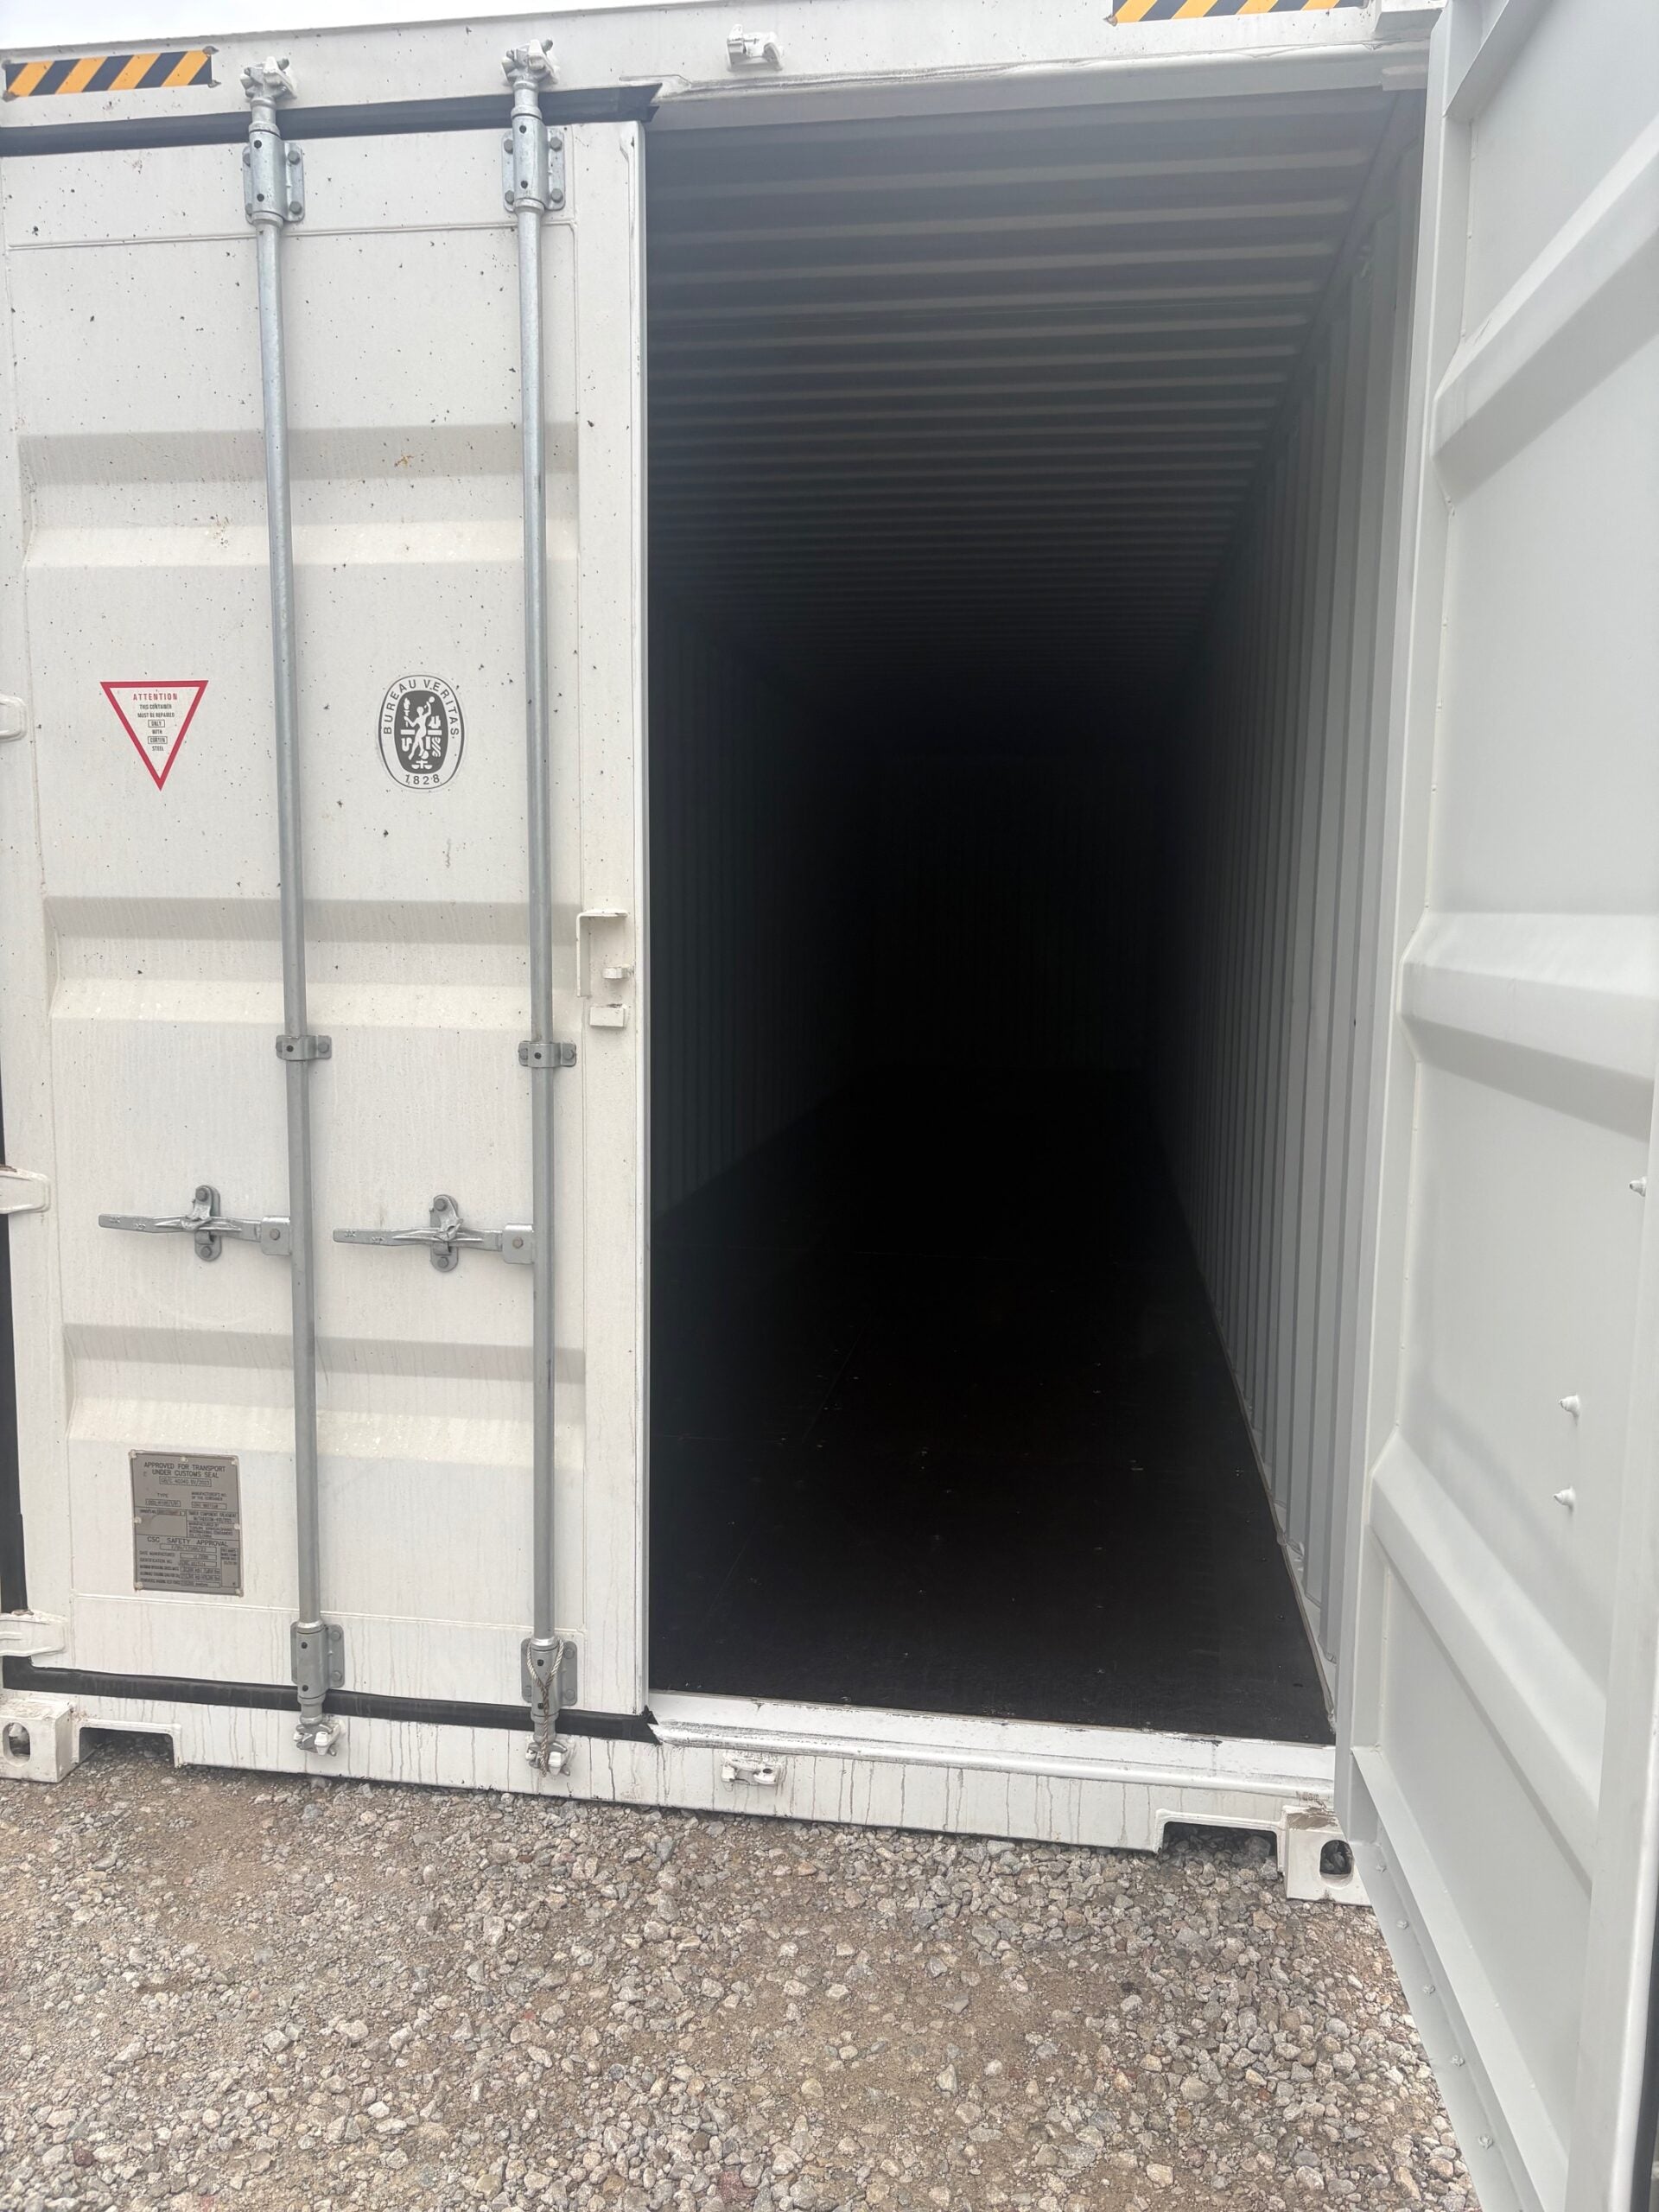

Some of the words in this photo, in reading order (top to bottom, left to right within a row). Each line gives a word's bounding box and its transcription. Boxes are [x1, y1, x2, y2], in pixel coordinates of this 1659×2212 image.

[383, 679, 416, 734] BUREAU
[423, 679, 460, 736] VERITAS
[405, 773, 440, 785] 1828
